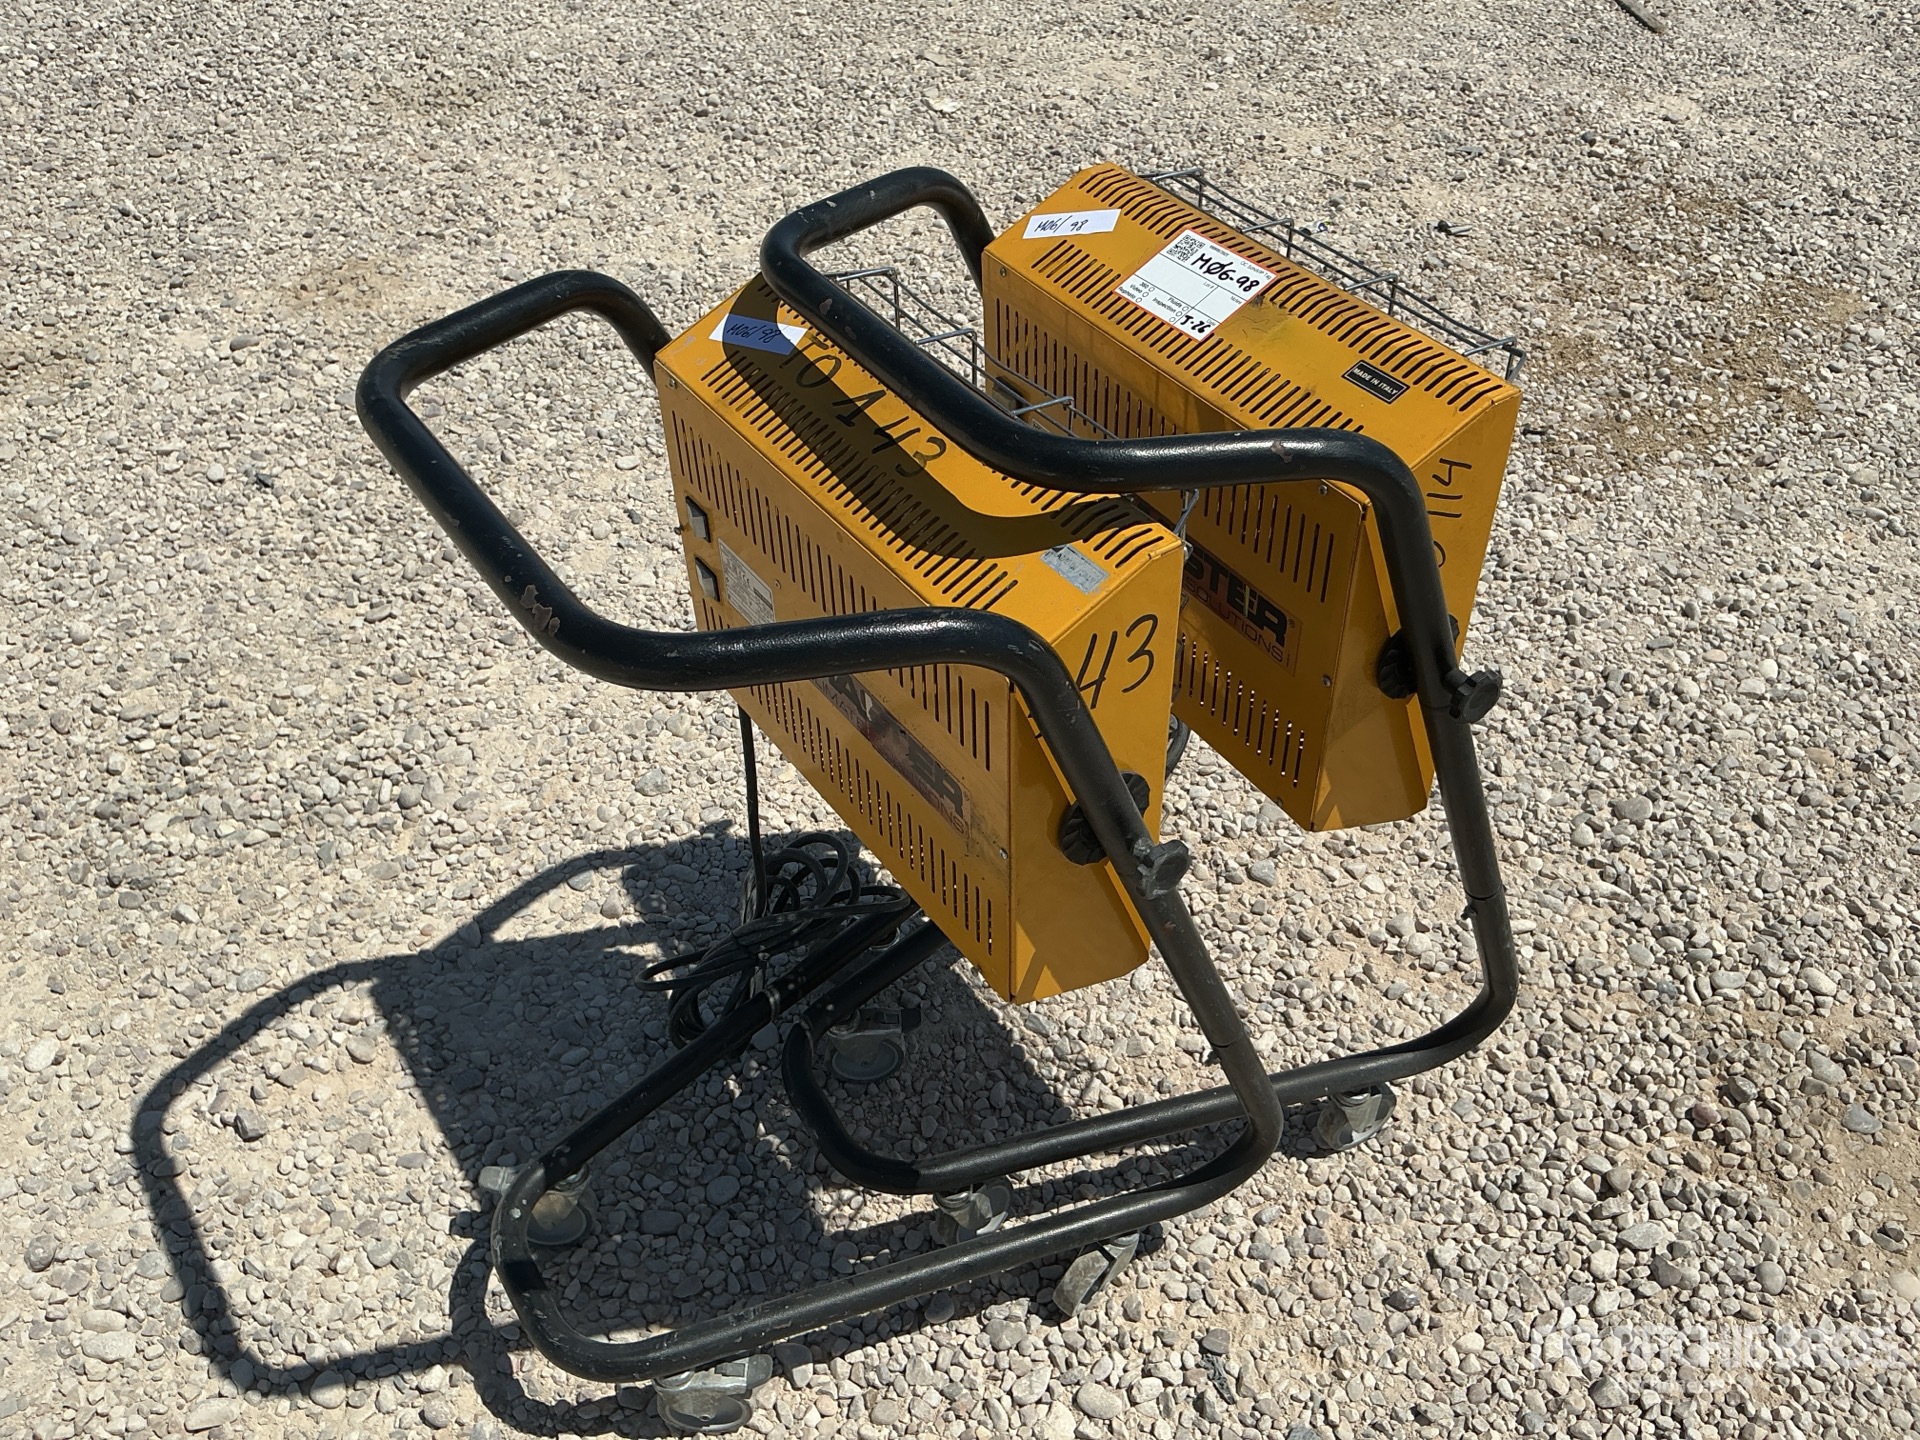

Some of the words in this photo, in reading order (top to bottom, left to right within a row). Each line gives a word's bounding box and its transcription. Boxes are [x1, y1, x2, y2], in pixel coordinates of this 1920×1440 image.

[1152, 296, 1177, 314] Inspection
[1167, 296, 1183, 309] Fluids
[1352, 367, 1373, 381] MADE
[1370, 377, 1381, 386] IN
[1378, 382, 1399, 395] ITALY
[1184, 540, 1288, 648] STER
